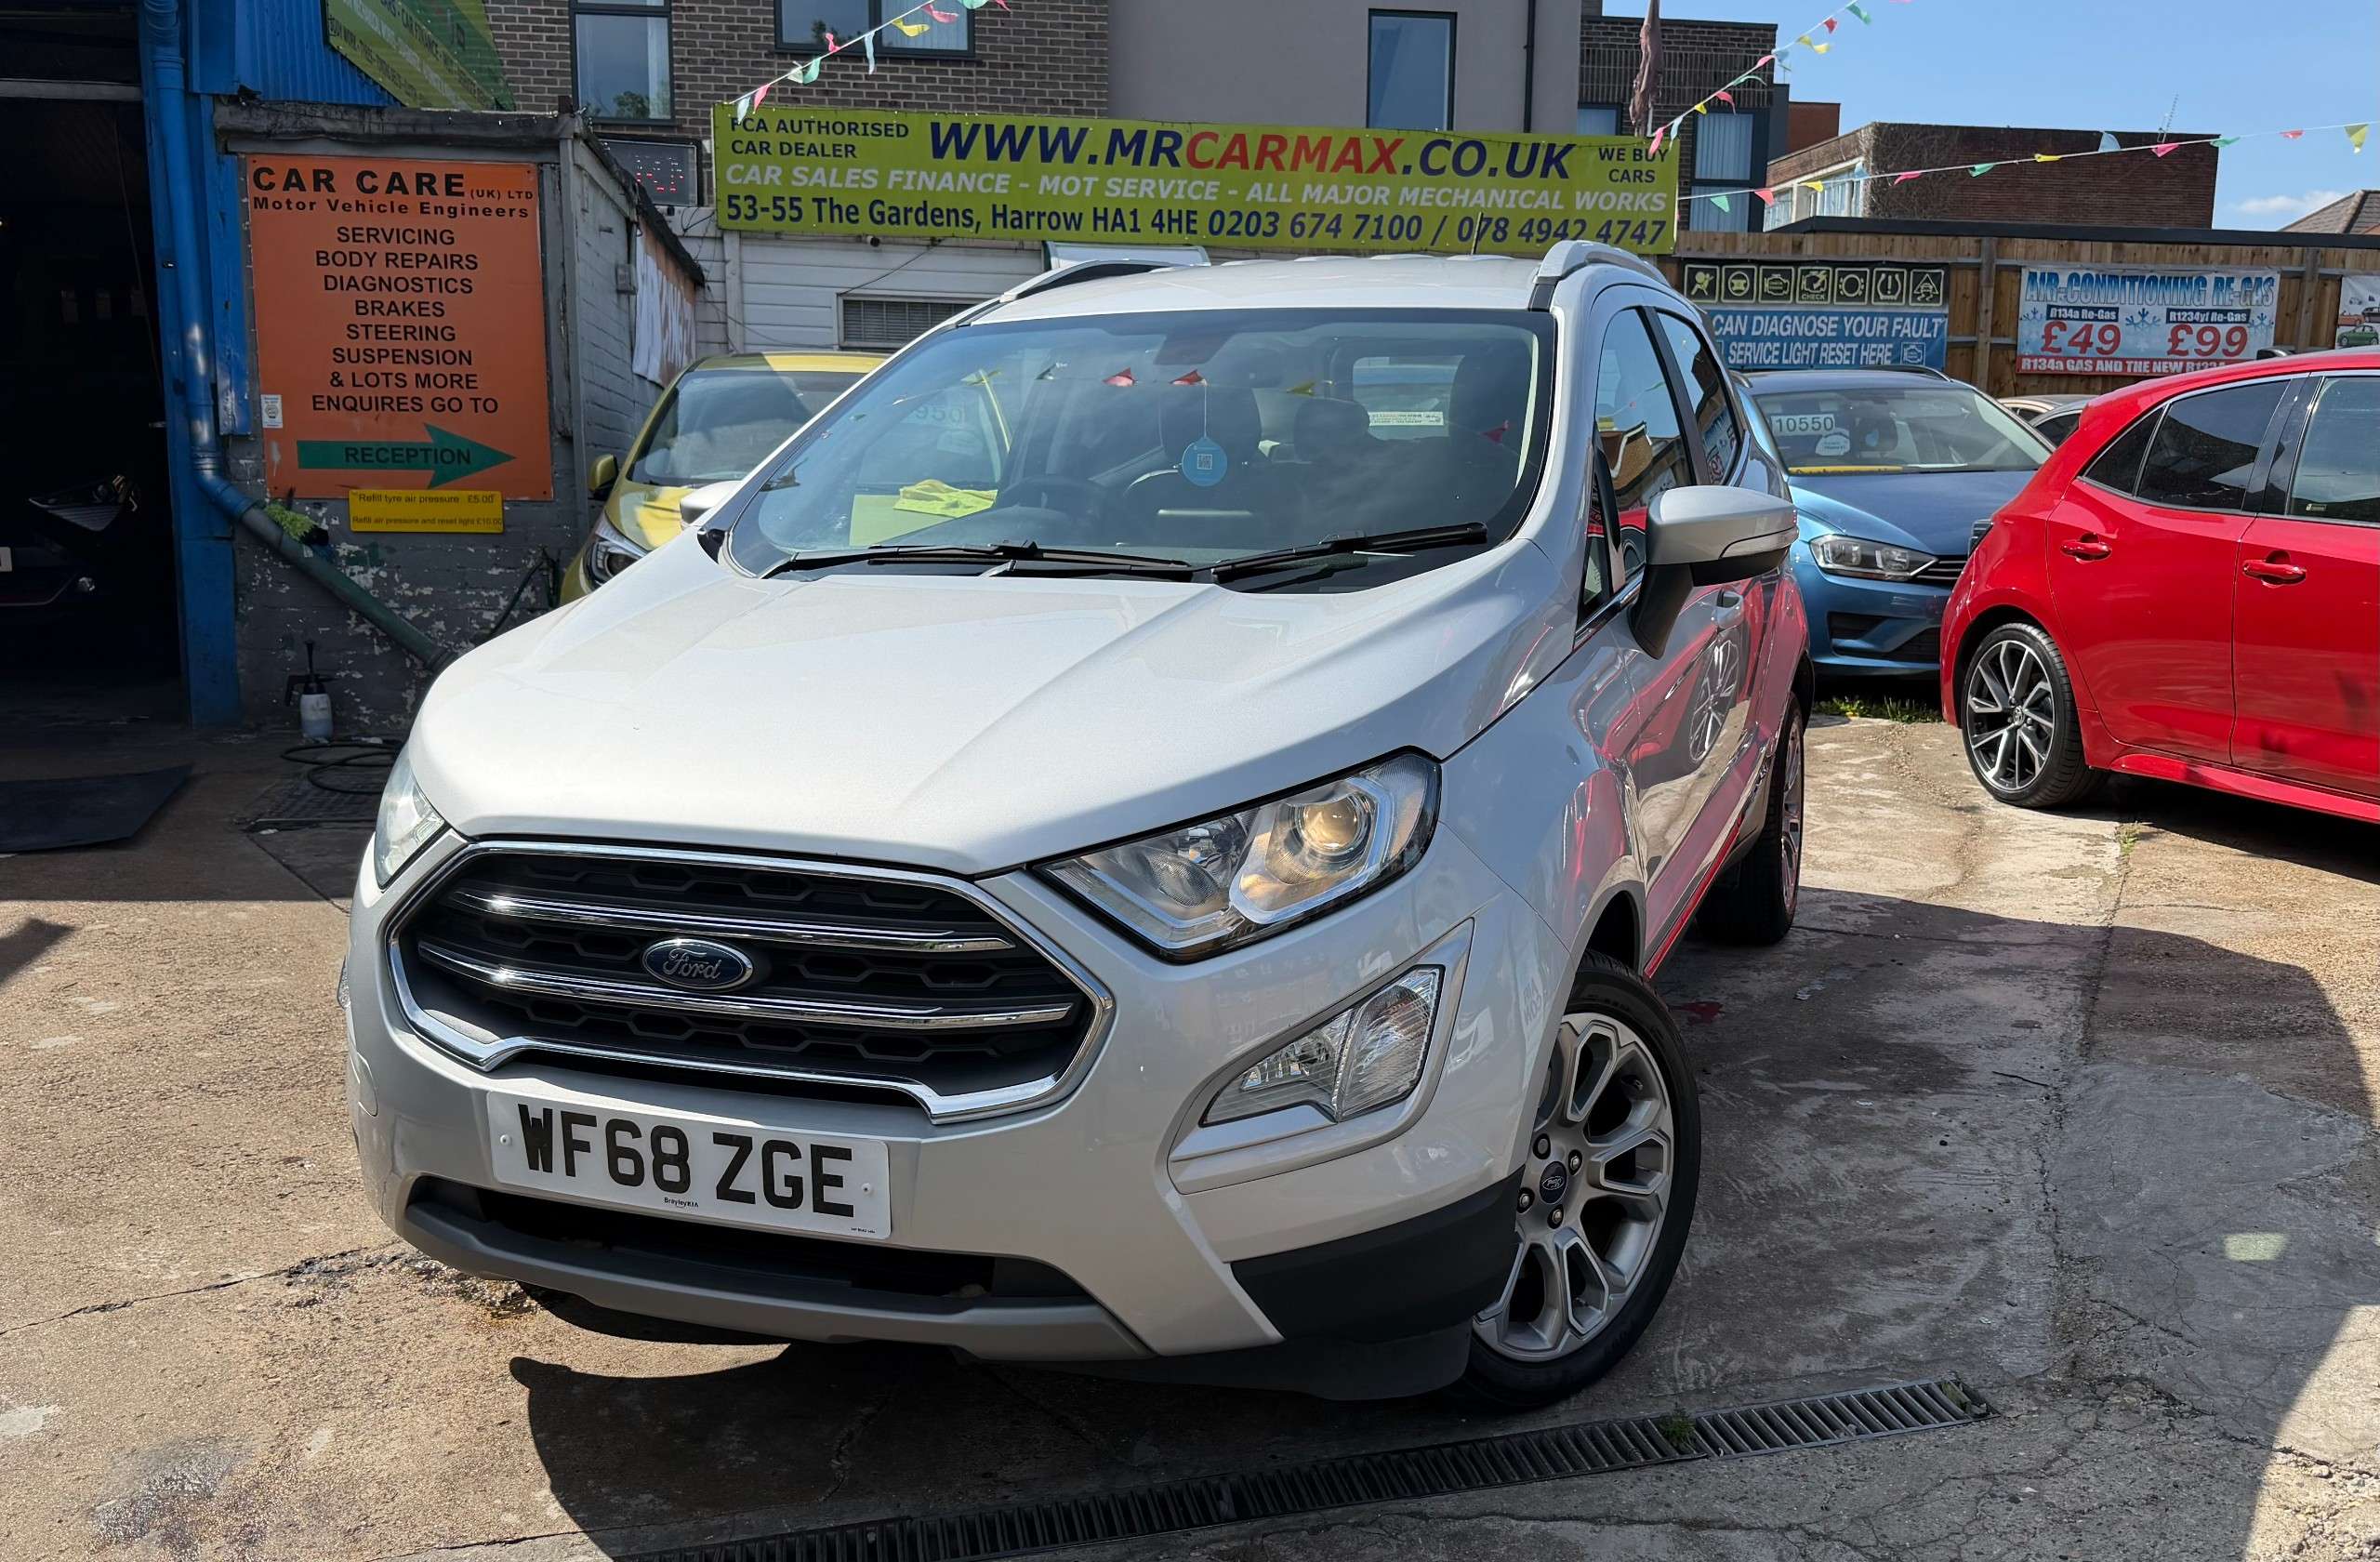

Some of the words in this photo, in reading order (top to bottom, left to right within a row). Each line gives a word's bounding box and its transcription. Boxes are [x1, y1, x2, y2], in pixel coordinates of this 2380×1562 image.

[731, 117, 768, 133] FCA
[775, 119, 908, 139] AUTHORISED
[732, 140, 773, 155] CAR
[779, 142, 857, 158] DEALER
[930, 121, 1577, 180] WWW.MRCARMAX.CO.UK
[1598, 148, 1626, 161] WE
[1633, 148, 1669, 162] BUY
[252, 166, 336, 193] CAR
[355, 169, 465, 197] CARE
[469, 189, 502, 200] (UK)
[508, 189, 535, 201] LTD
[1608, 169, 1655, 183] CARS
[726, 164, 783, 186] CAR
[791, 165, 879, 190] SALES
[886, 170, 1012, 194] FINANCE
[1038, 174, 1100, 196] MOT
[1105, 178, 1219, 202] SERVICE
[1245, 182, 1293, 205] ALL
[1301, 183, 1391, 207] MAJOR
[1397, 186, 1565, 210] MECHANICAL
[1575, 192, 1667, 212] WORKS
[253, 196, 317, 211] Motor
[326, 198, 410, 215] Vehicle
[419, 201, 530, 218] Engineers
[727, 194, 803, 223] 53-55
[812, 197, 861, 224] The
[868, 199, 982, 233] Gardens,
[991, 203, 1083, 232] Harrow
[1092, 206, 1142, 233] HA1
[1150, 207, 1198, 235] 4HE
[1208, 210, 1279, 238] 0203
[1289, 211, 1343, 240] 674
[1354, 214, 1422, 241] 7100
[1457, 216, 1510, 243] 078
[1517, 218, 1587, 244] 4942
[1595, 219, 1667, 245] 4747
[337, 226, 455, 245] SERVICING
[315, 251, 377, 268] BODY
[385, 252, 479, 271] REPAIRS
[324, 275, 473, 295] DIAGNOSTICS
[2025, 271, 2207, 307] AIR-CONDITIONING
[2212, 275, 2275, 307] RE-GAS
[354, 299, 445, 317] BRAKES
[2050, 308, 2080, 320] R134a
[2081, 309, 2116, 321] Re-Gas
[346, 324, 456, 341] STEERING
[1712, 314, 1747, 337] CAN
[1751, 315, 1839, 338] DIAGNOSE
[1844, 317, 1889, 338] YOUR
[1891, 318, 1943, 338] FAULT
[2041, 321, 2122, 355] £49
[2166, 323, 2248, 357] £99
[332, 348, 472, 365] SUSPENSION
[1727, 342, 1780, 365] SERVICE
[1782, 342, 1819, 365] LIGHT
[1821, 343, 1858, 365] RESET
[1859, 344, 1892, 365] HERE
[2021, 359, 2064, 372] R134a
[2066, 360, 2093, 372] GAS
[2096, 360, 2122, 372] AND
[2125, 361, 2151, 373] THE
[2152, 361, 2184, 373] NEW
[330, 372, 345, 389] &
[351, 372, 407, 389] LOTS
[415, 373, 479, 390] MORE
[311, 395, 424, 413] ENQUIRES
[430, 396, 464, 414] GO
[469, 397, 498, 414] TO
[1778, 417, 1834, 432] 10550
[344, 446, 471, 465] RECEPTION
[359, 493, 383, 503] Refill
[385, 494, 402, 505] tyre
[404, 494, 416, 503] air
[419, 496, 459, 506] pressure
[663, 947, 722, 979] Ford
[518, 1104, 691, 1194] WF68
[712, 1132, 854, 1218] ZGE
